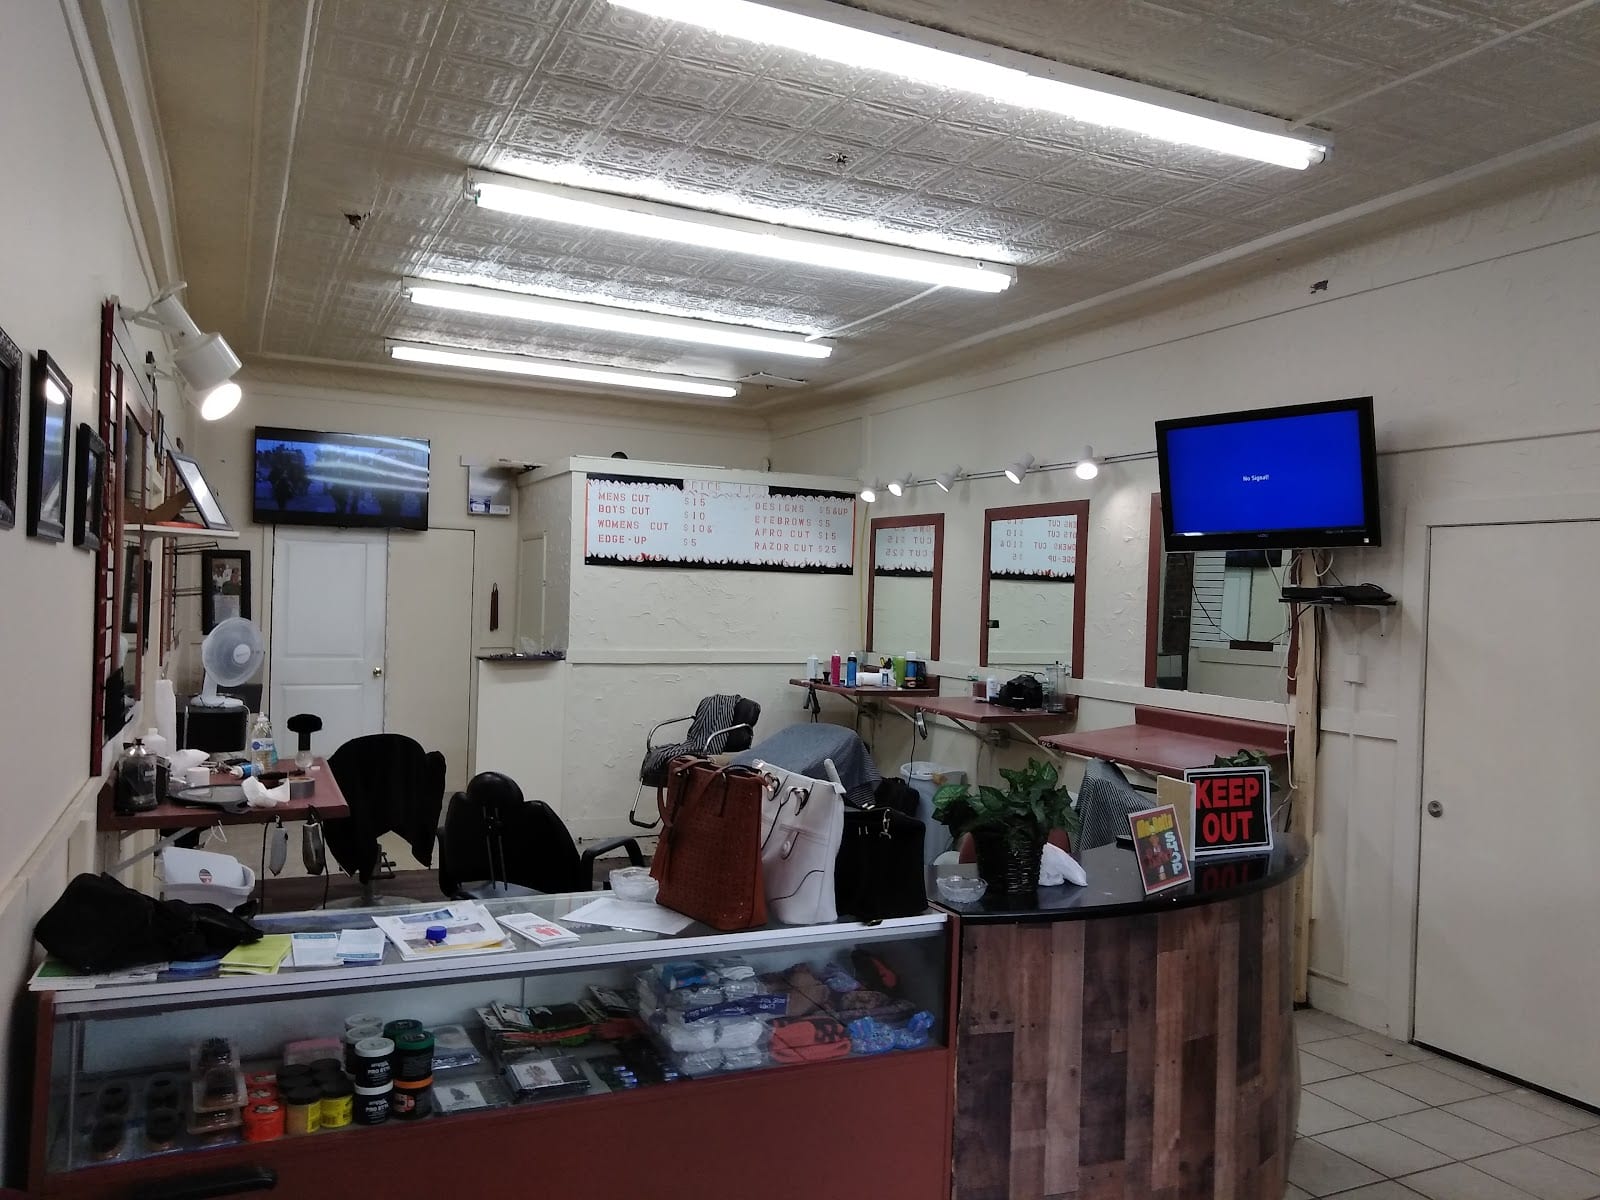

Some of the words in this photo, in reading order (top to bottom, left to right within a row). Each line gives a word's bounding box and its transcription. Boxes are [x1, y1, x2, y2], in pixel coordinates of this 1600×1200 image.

[1251, 474, 1270, 482] Signal!
[598, 492, 626, 502] MENS
[631, 494, 651, 503] CUT
[684, 497, 706, 508] $15
[598, 504, 626, 514] BOYS
[631, 506, 651, 516] CUT
[684, 511, 706, 521] $10
[755, 501, 805, 513] DESIGNS
[597, 519, 640, 530] WOMENS
[650, 522, 669, 532] CUT
[754, 516, 812, 527] EYEBROWS
[818, 519, 831, 528] $5
[754, 528, 783, 538] AFRO
[790, 529, 811, 539] CUT
[818, 531, 837, 541] $15
[683, 538, 697, 547] $5
[754, 541, 790, 551] RAZOR
[793, 542, 814, 553] CUT
[1194, 777, 1260, 809] KEEP
[1202, 810, 1253, 844] OUT
